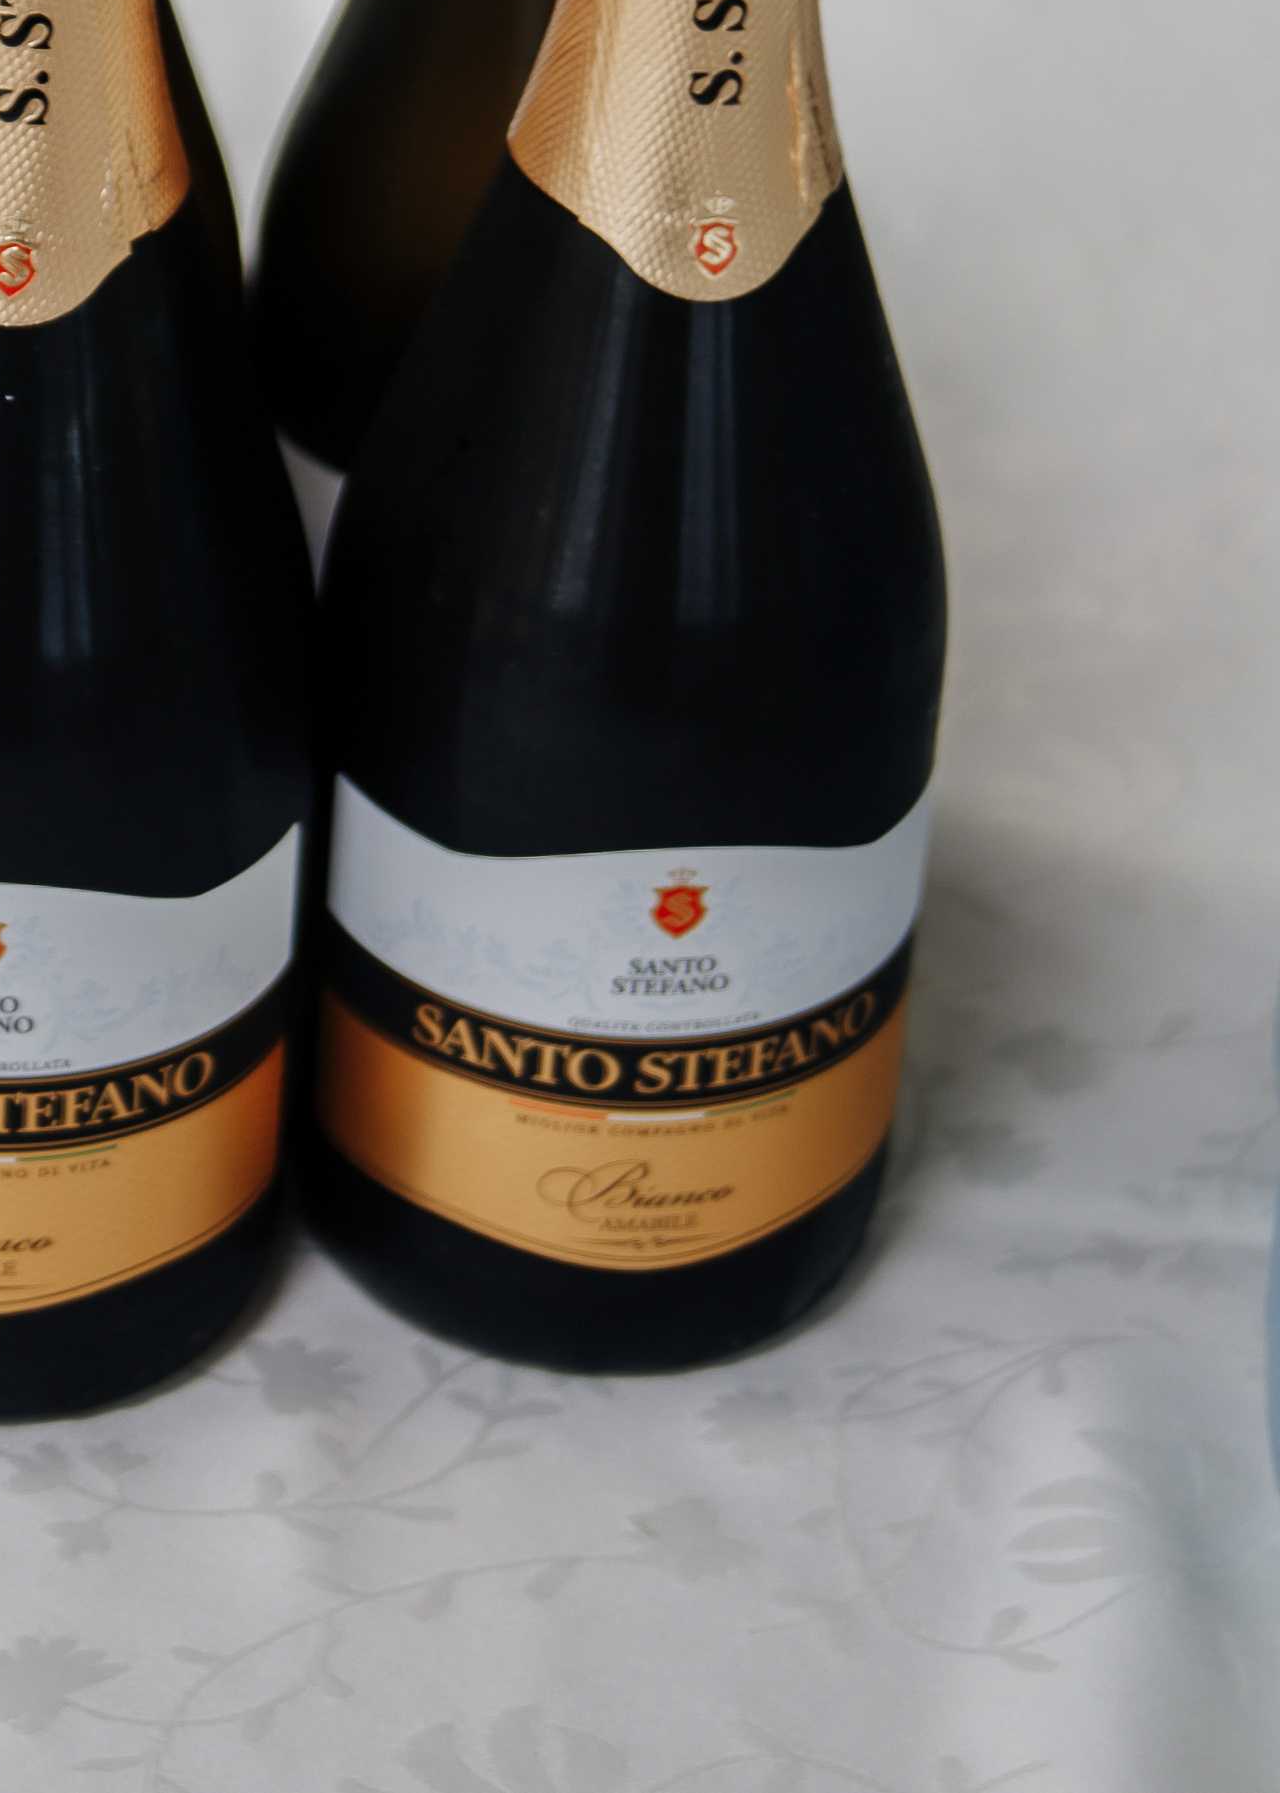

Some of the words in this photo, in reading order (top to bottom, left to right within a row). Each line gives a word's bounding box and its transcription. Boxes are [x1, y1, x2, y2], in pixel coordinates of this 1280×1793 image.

[688, 50, 744, 107] S.
[611, 973, 731, 996] STEFANO
[629, 955, 718, 976] SANTO
[412, 1003, 620, 1092] SANTO
[632, 991, 875, 1095] STEFANO
[535, 1158, 735, 1223] Bianco
